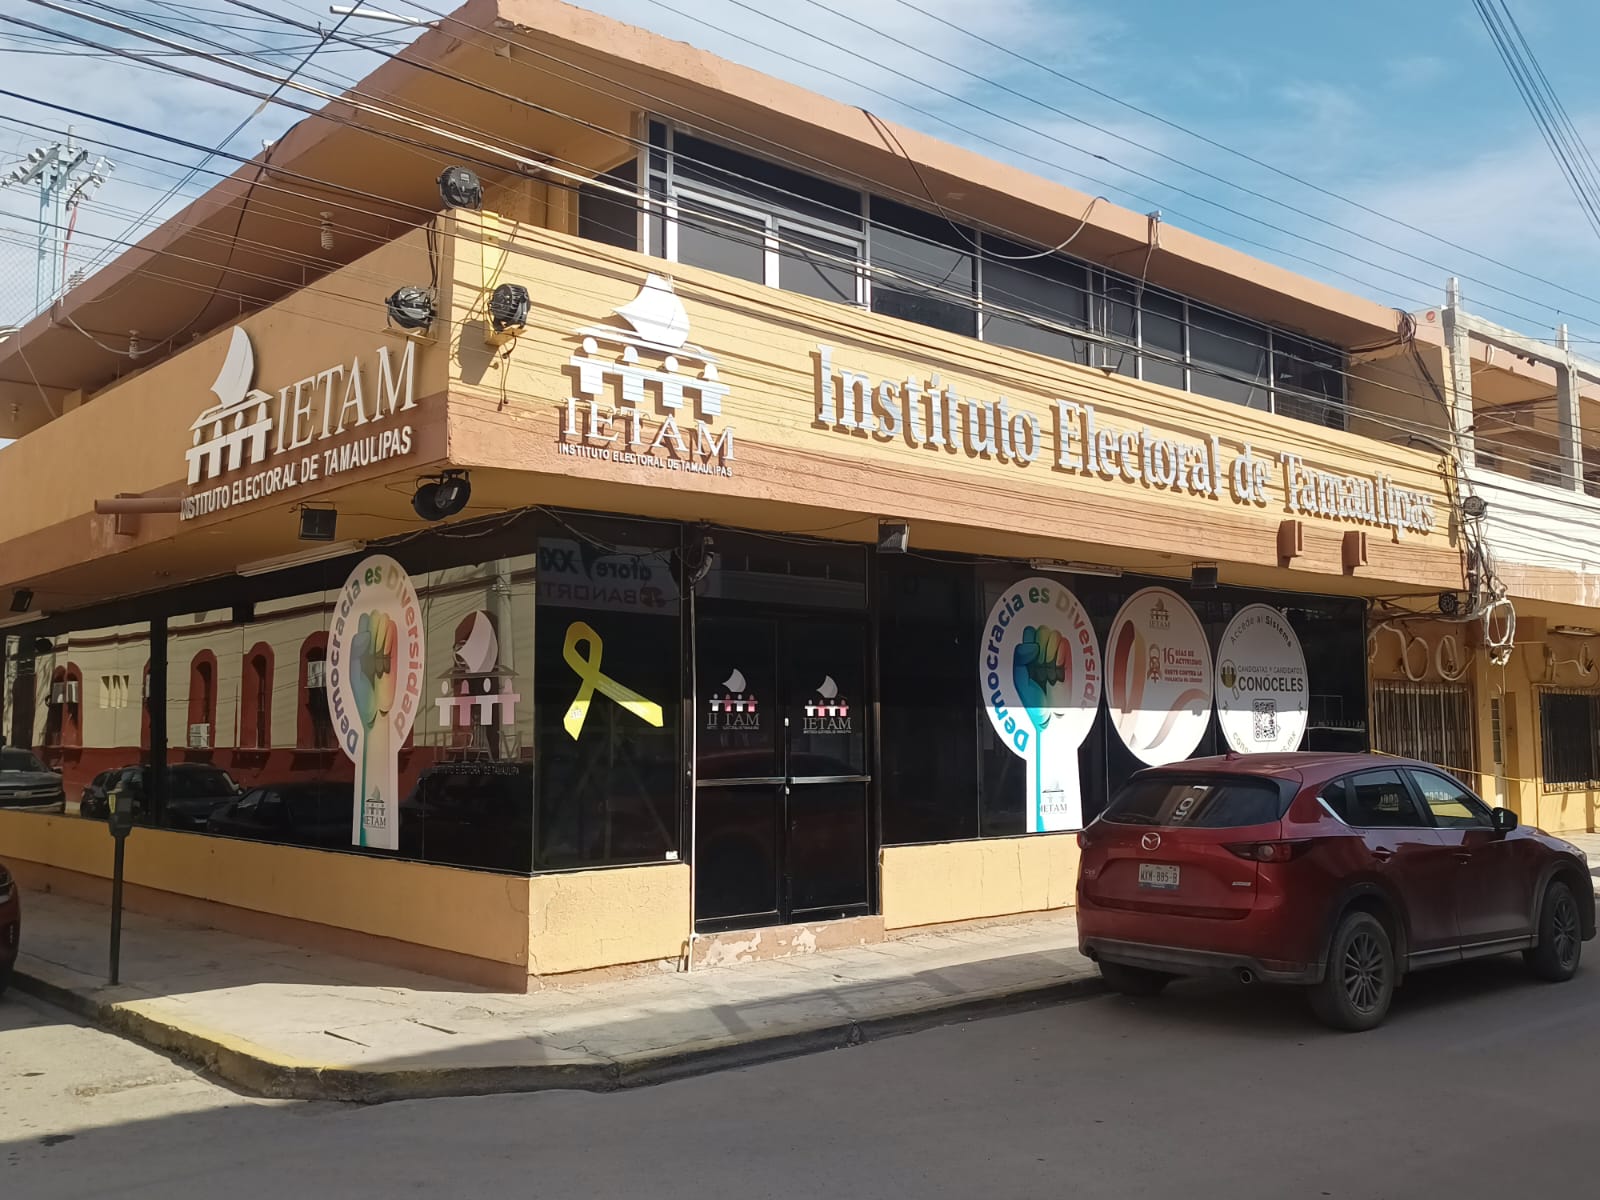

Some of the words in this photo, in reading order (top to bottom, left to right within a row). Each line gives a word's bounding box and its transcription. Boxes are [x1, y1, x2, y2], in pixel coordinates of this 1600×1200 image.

[273, 340, 418, 456] IETAM
[562, 396, 737, 461] IETAM
[180, 488, 230, 521] INSTITUTO
[231, 462, 297, 505] ELECTORAL
[300, 453, 319, 484] DE
[323, 425, 412, 476] TAMAULIPAS
[557, 442, 609, 461] INSTITUTO
[612, 450, 665, 469] ELECTORAL
[667, 458, 679, 470] DE
[679, 461, 733, 478] TAMAULIPAS
[816, 343, 1041, 462] Instituto
[1055, 397, 1223, 495] Electoral
[1233, 440, 1274, 502] de
[1279, 450, 1437, 538] Tamaulipas
[330, 579, 361, 756] Democracia
[365, 565, 383, 586] es
[385, 564, 422, 740] Diversidad
[1163, 647, 1174, 665] 16
[1265, 615, 1292, 648] Sistema
[986, 593, 1030, 753] Democracia
[1029, 587, 1050, 603] es
[803, 717, 852, 730] IETAM
[1040, 803, 1068, 813] IETAM
